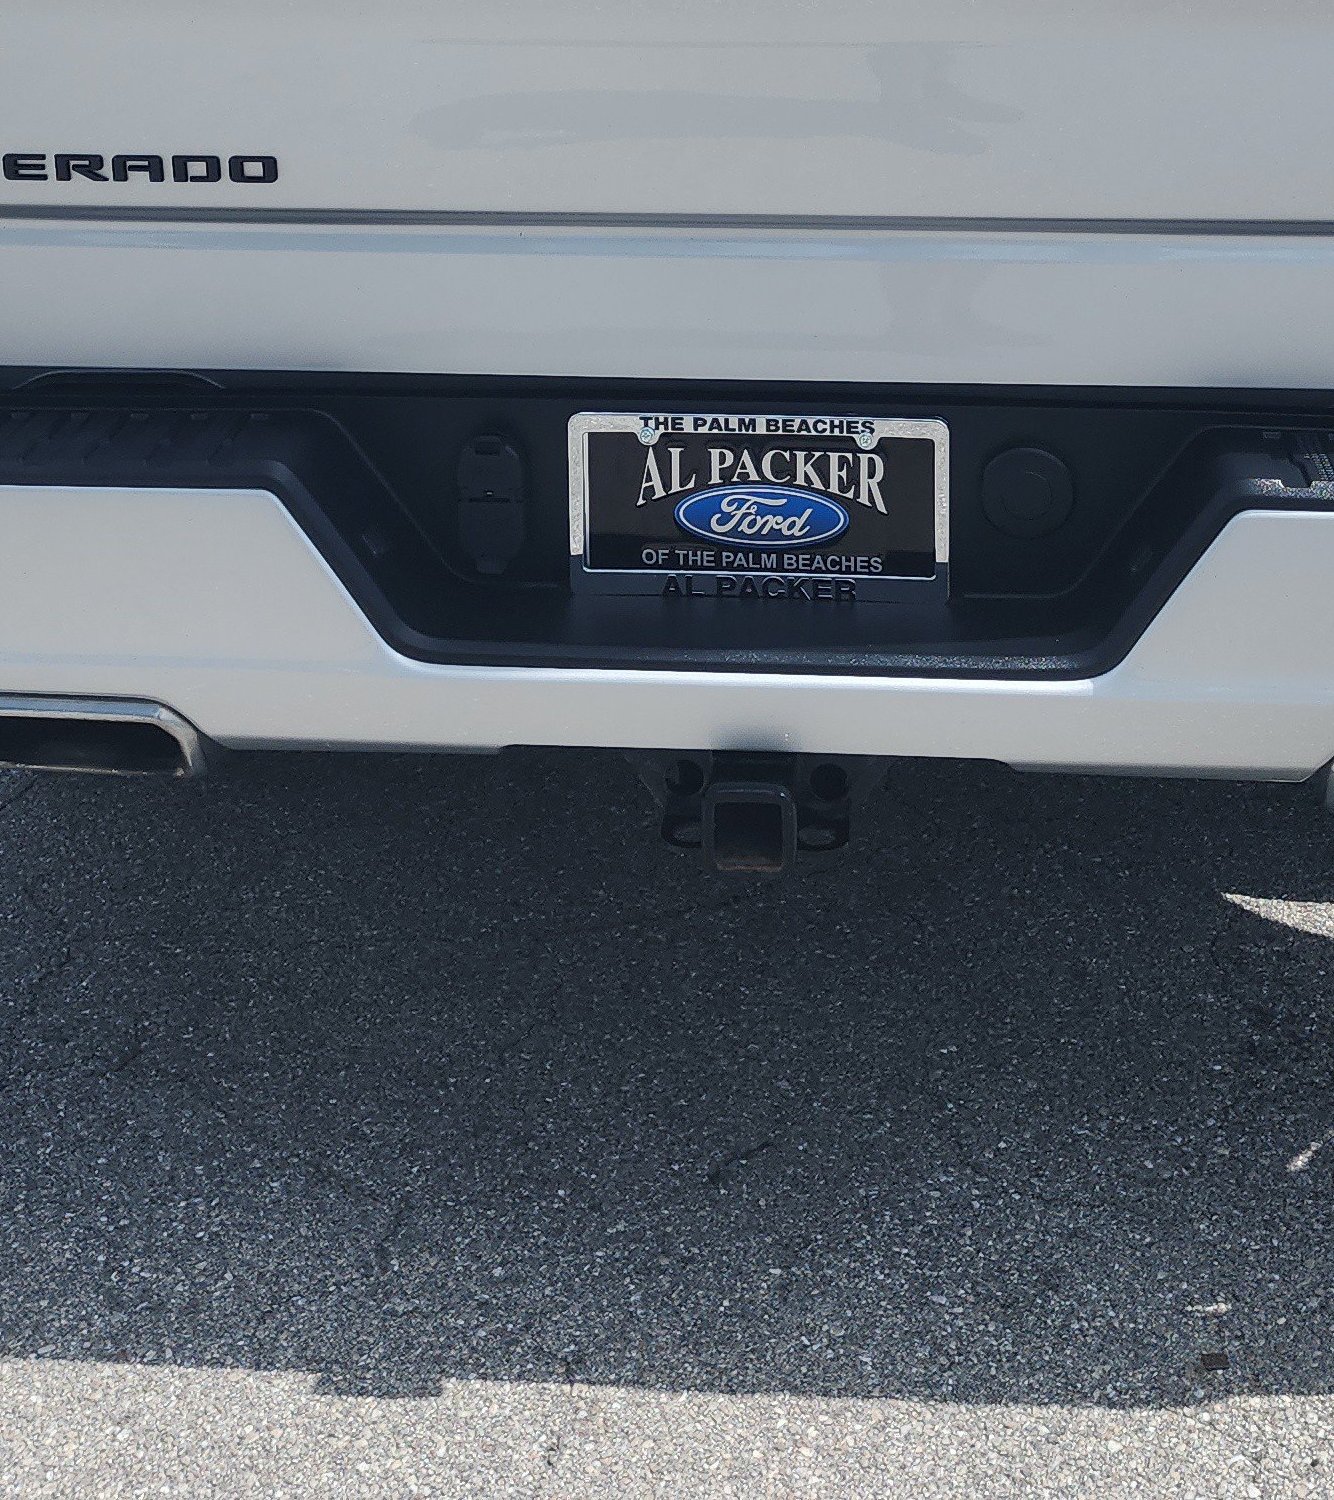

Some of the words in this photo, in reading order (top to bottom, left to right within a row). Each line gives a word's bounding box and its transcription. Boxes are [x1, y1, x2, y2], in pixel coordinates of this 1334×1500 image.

[639, 416, 685, 432] THE
[693, 417, 757, 433] PALM
[765, 418, 876, 435] BEACHES
[636, 446, 697, 507] AL
[707, 447, 889, 515] PACKER
[710, 494, 813, 537] Ford
[641, 549, 670, 565] OF
[675, 550, 716, 567] THE
[721, 552, 778, 569] PALM
[783, 554, 884, 573] BEACHES
[662, 574, 705, 597] AL
[714, 576, 858, 601] PACKER
